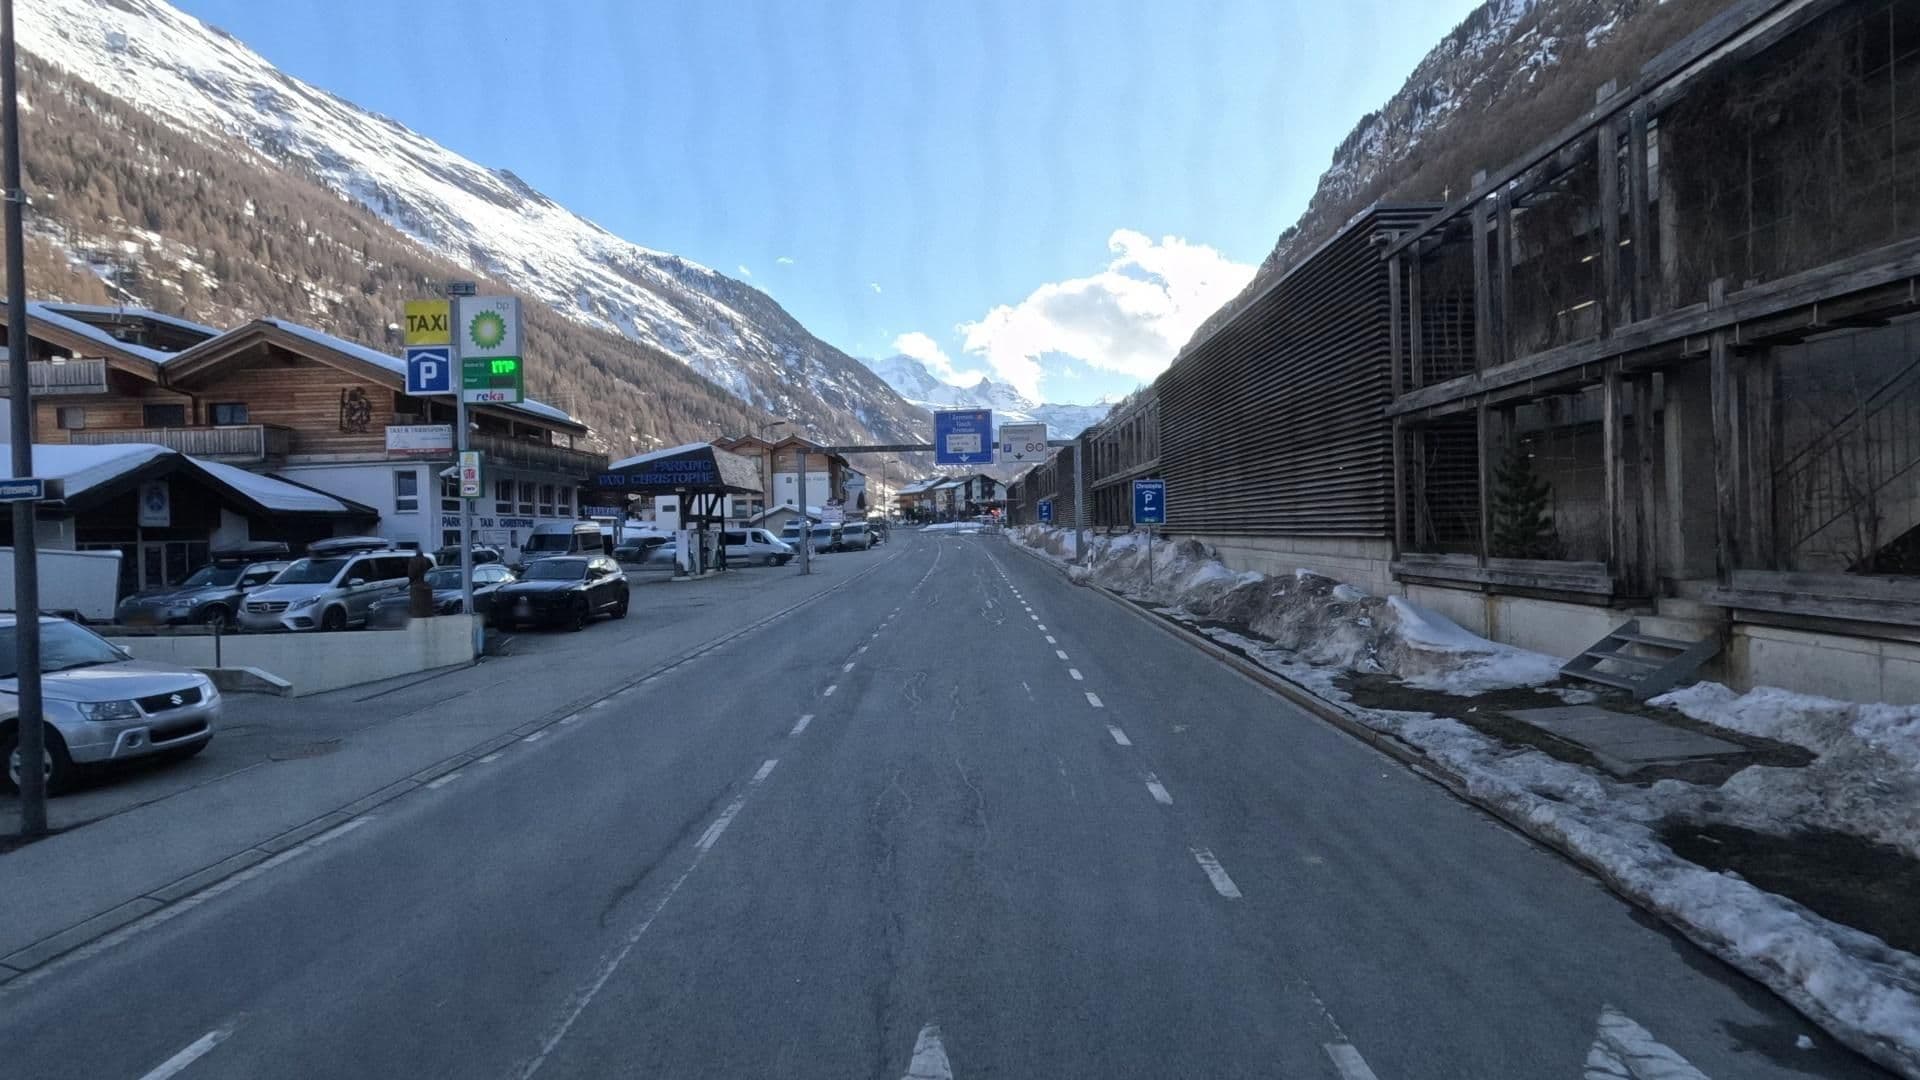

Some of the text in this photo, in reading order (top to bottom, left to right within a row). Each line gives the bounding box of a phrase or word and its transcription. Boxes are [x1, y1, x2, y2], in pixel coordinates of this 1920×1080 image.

[496, 301, 510, 311] bp
[406, 313, 448, 332] TAXI
[420, 361, 437, 389] P
[476, 391, 505, 401] reka
[654, 460, 711, 471] PARKING
[631, 472, 714, 484] CHRISTOPHE
[1145, 493, 1153, 504] P
[480, 517, 494, 527] TAXI
[499, 518, 534, 528] CHRISTOPHE
